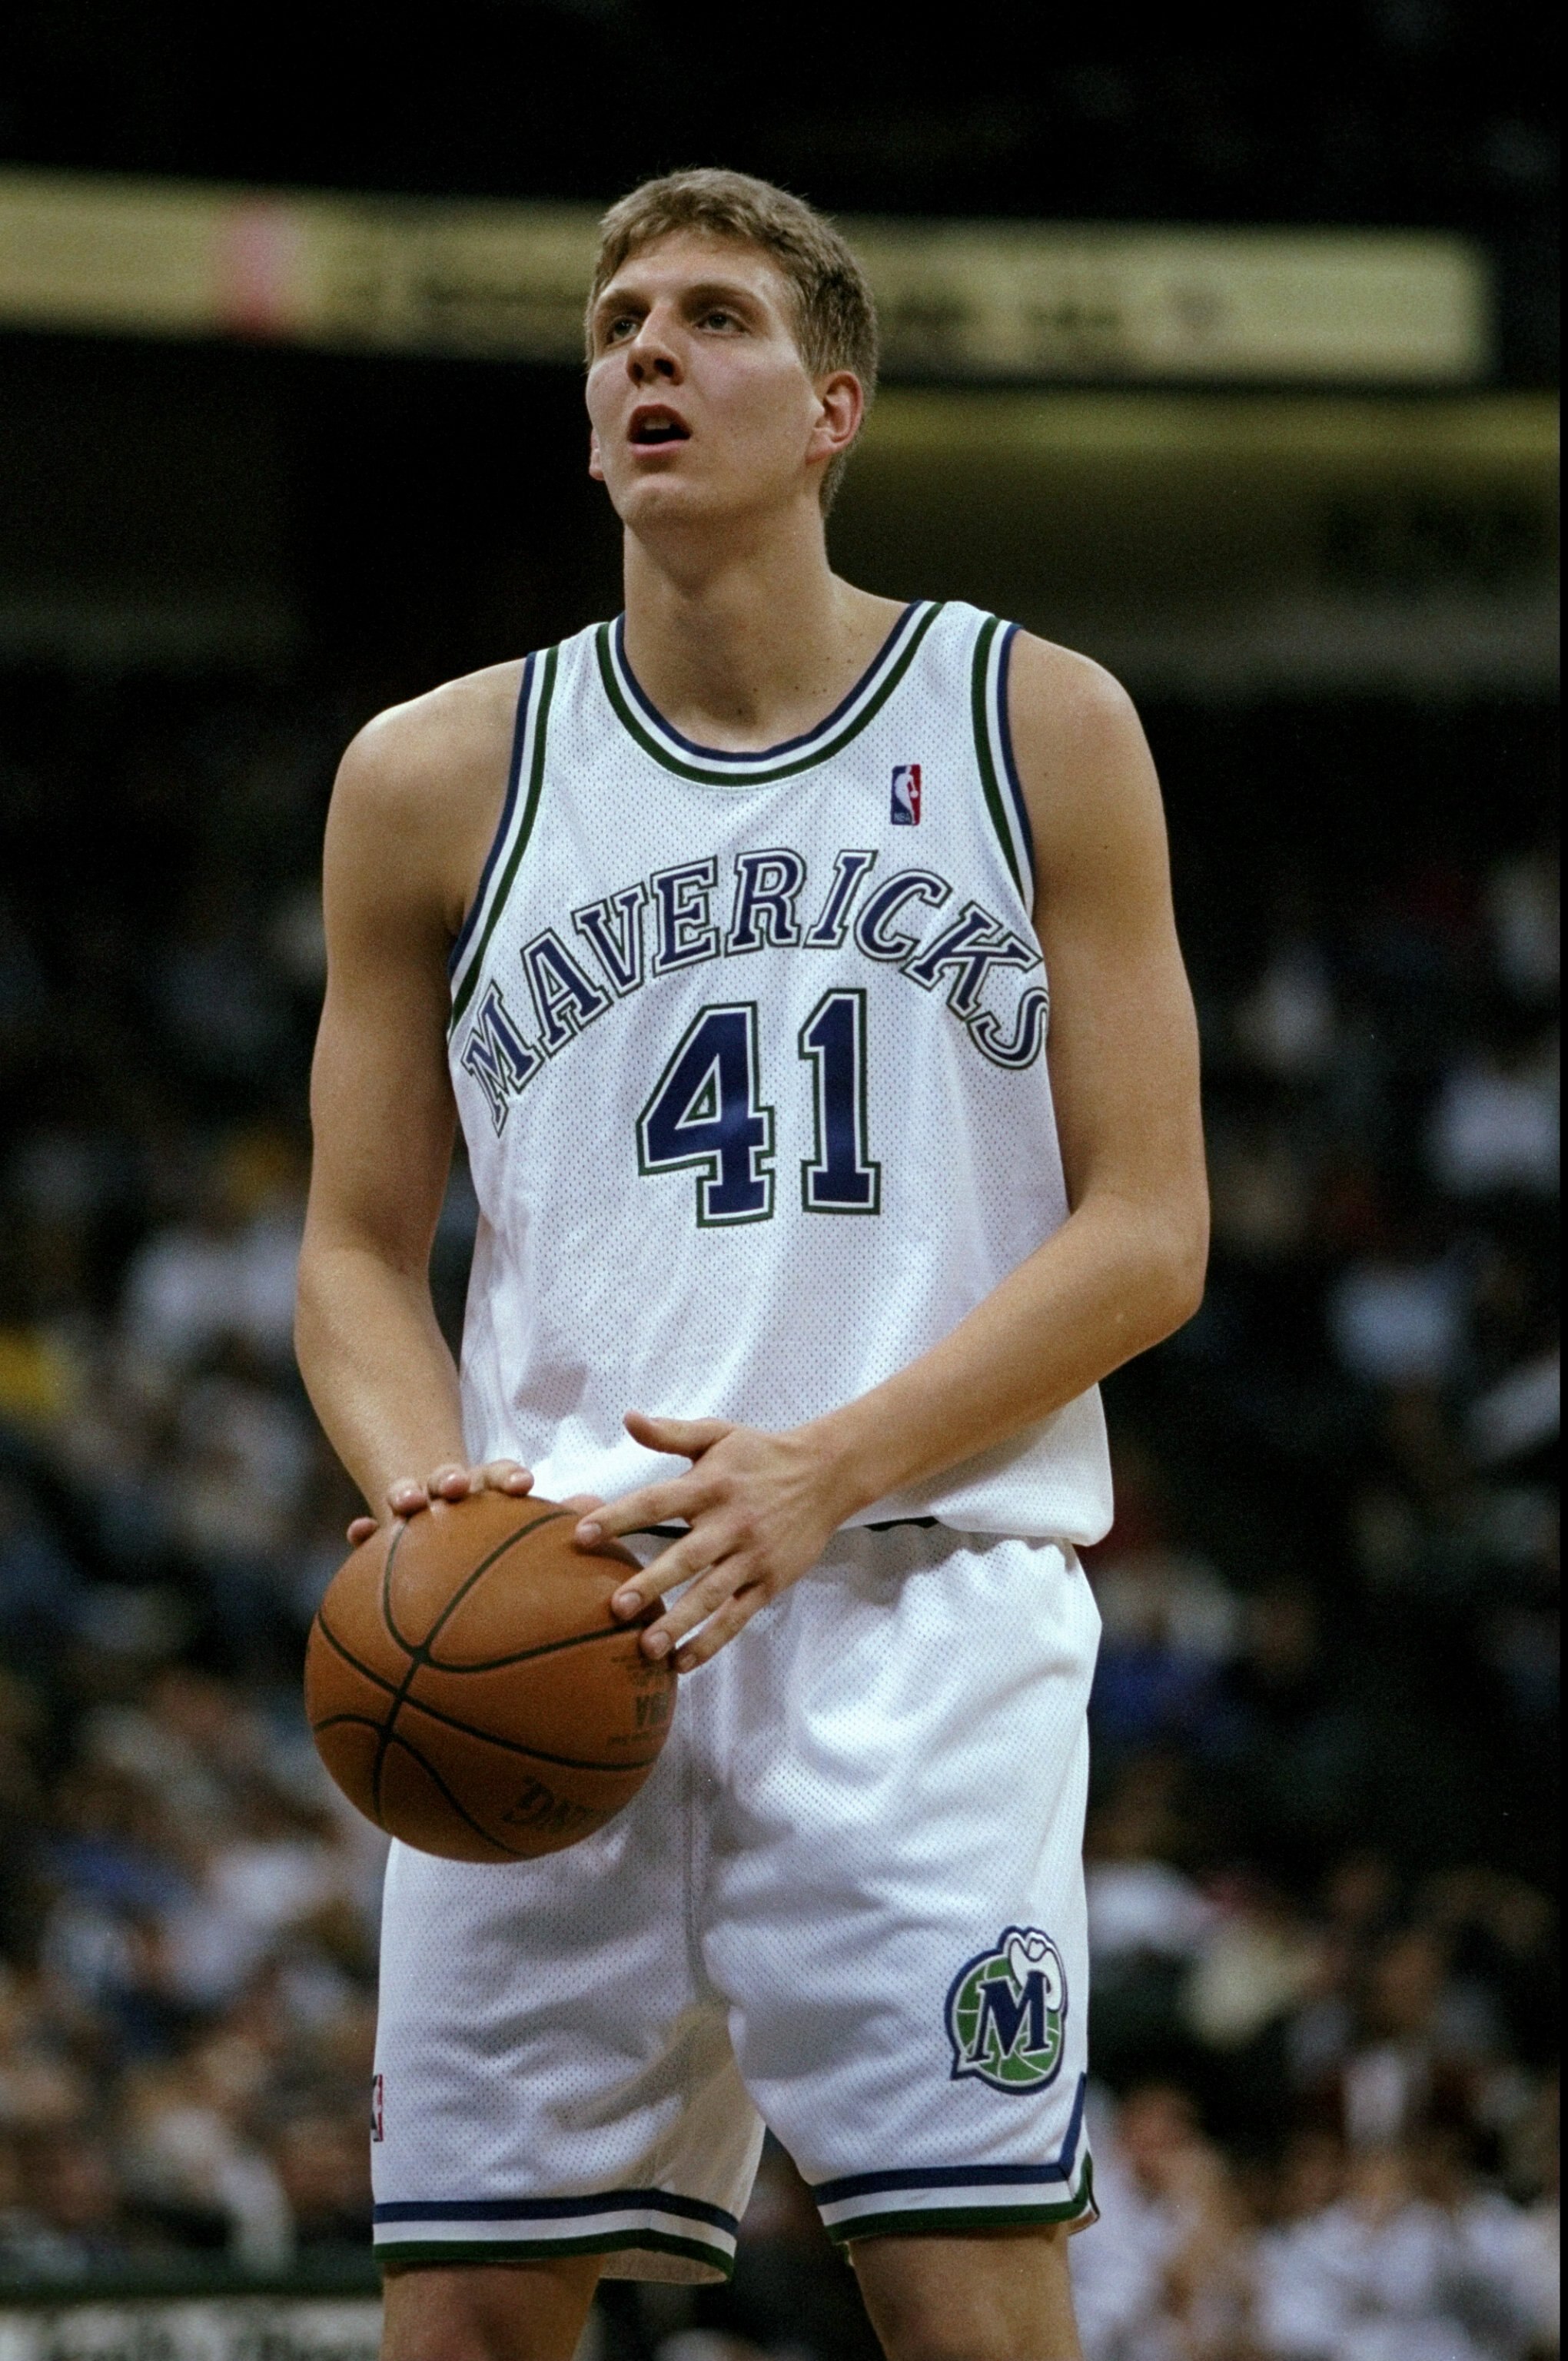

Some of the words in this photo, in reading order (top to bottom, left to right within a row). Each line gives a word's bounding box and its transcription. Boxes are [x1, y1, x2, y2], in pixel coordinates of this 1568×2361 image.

[894, 812, 911, 822] NBA
[462, 848, 1050, 1137] MAVERICKS
[636, 988, 880, 1227] 41
[965, 1971, 1053, 2064] M
